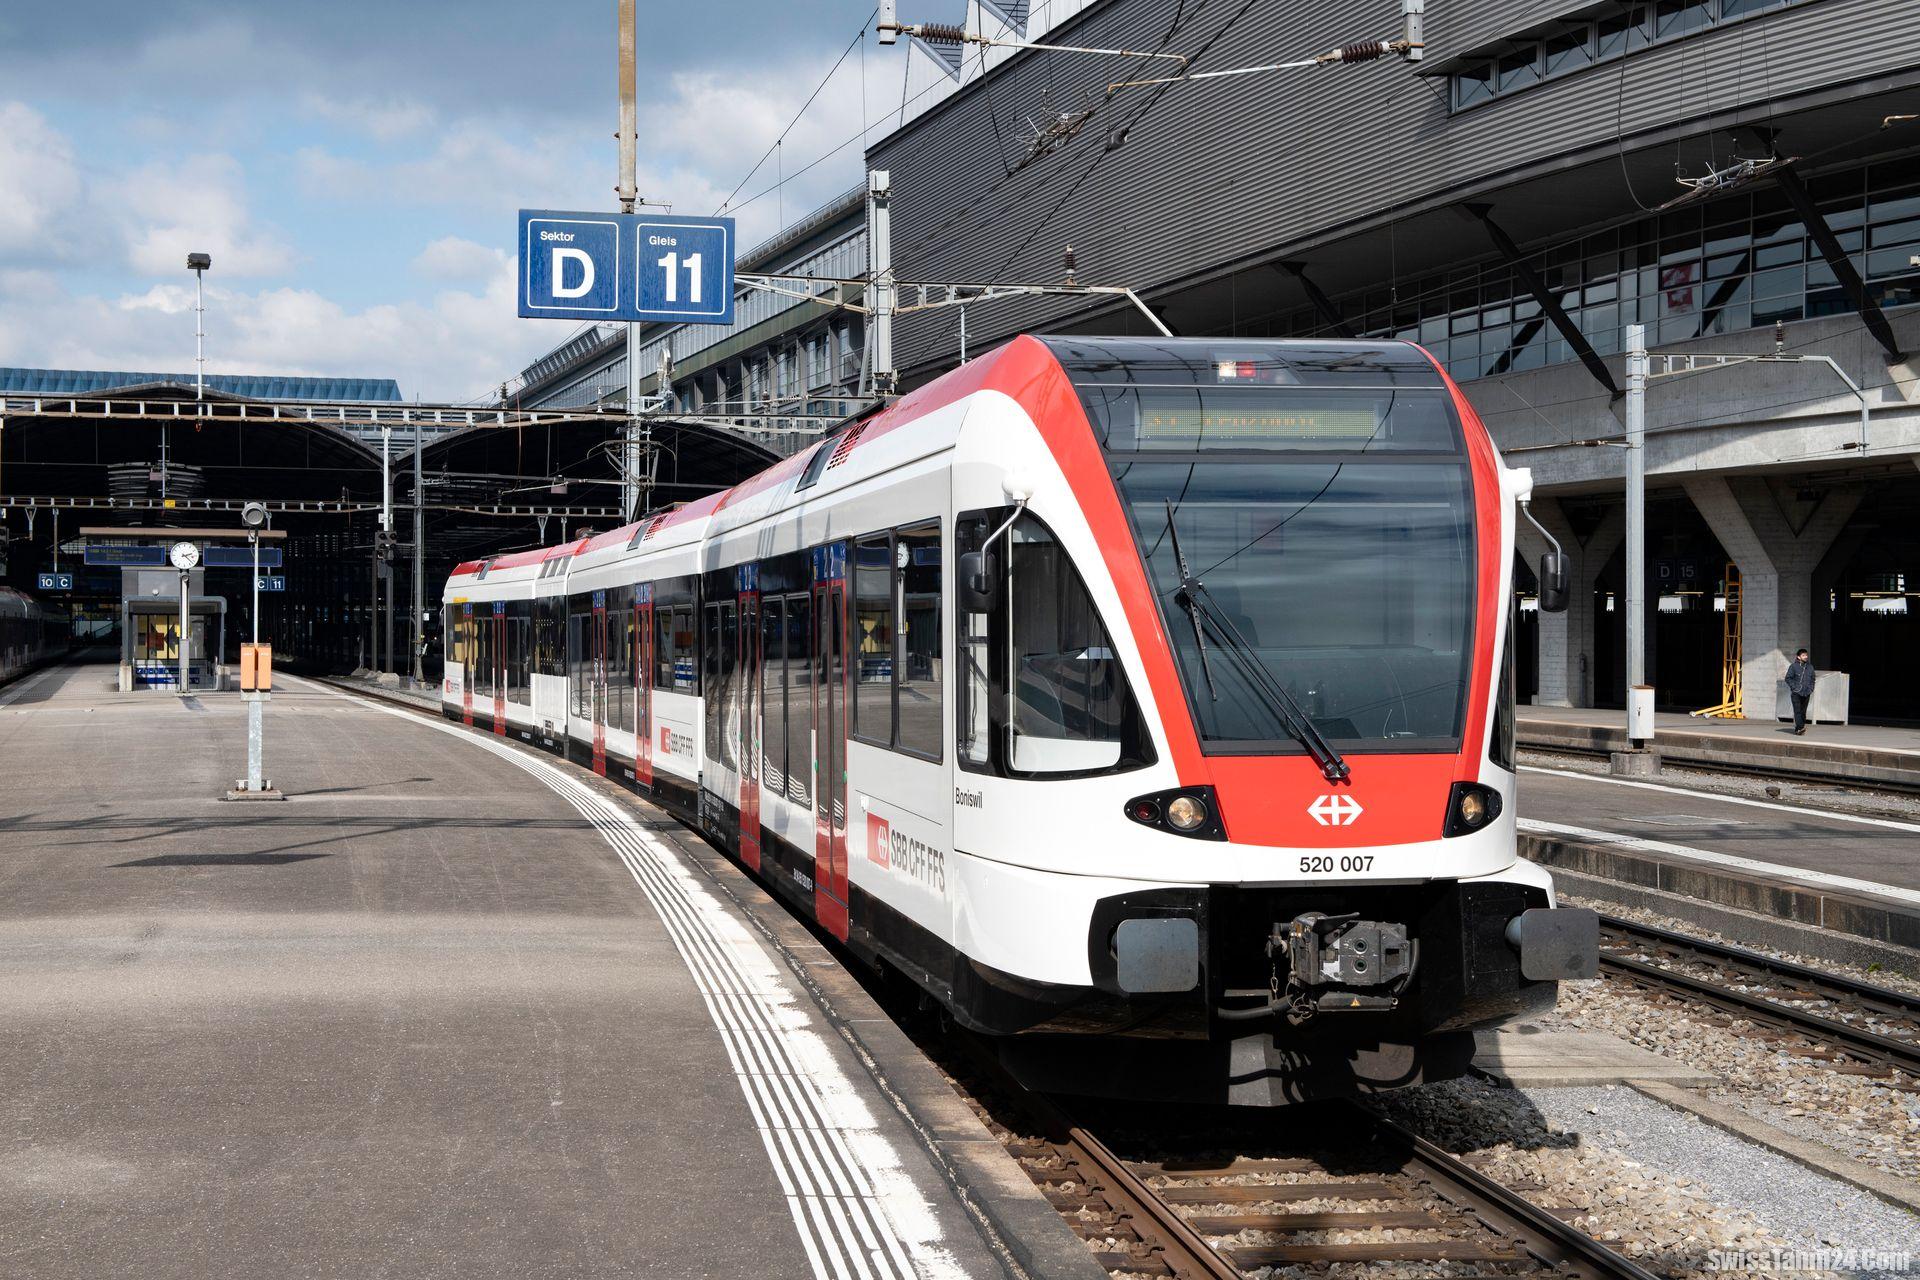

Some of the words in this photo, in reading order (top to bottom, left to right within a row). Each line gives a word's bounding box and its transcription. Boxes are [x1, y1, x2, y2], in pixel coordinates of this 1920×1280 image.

[540, 231, 575, 242] Sektor
[649, 236, 677, 246] Gleis
[552, 248, 595, 298] D
[658, 252, 702, 302] 11
[1660, 566, 1670, 577] D
[1681, 566, 1694, 577] 15
[41, 578, 53, 587] 10
[60, 578, 68, 587] C
[257, 580, 265, 589] C
[273, 580, 281, 589] 11
[955, 787, 983, 809] Boniswil
[891, 829, 908, 872] SBB
[909, 838, 926, 881] CFF
[927, 846, 945, 892] FFS
[1300, 856, 1334, 872] 520
[1340, 856, 1374, 872] 007
